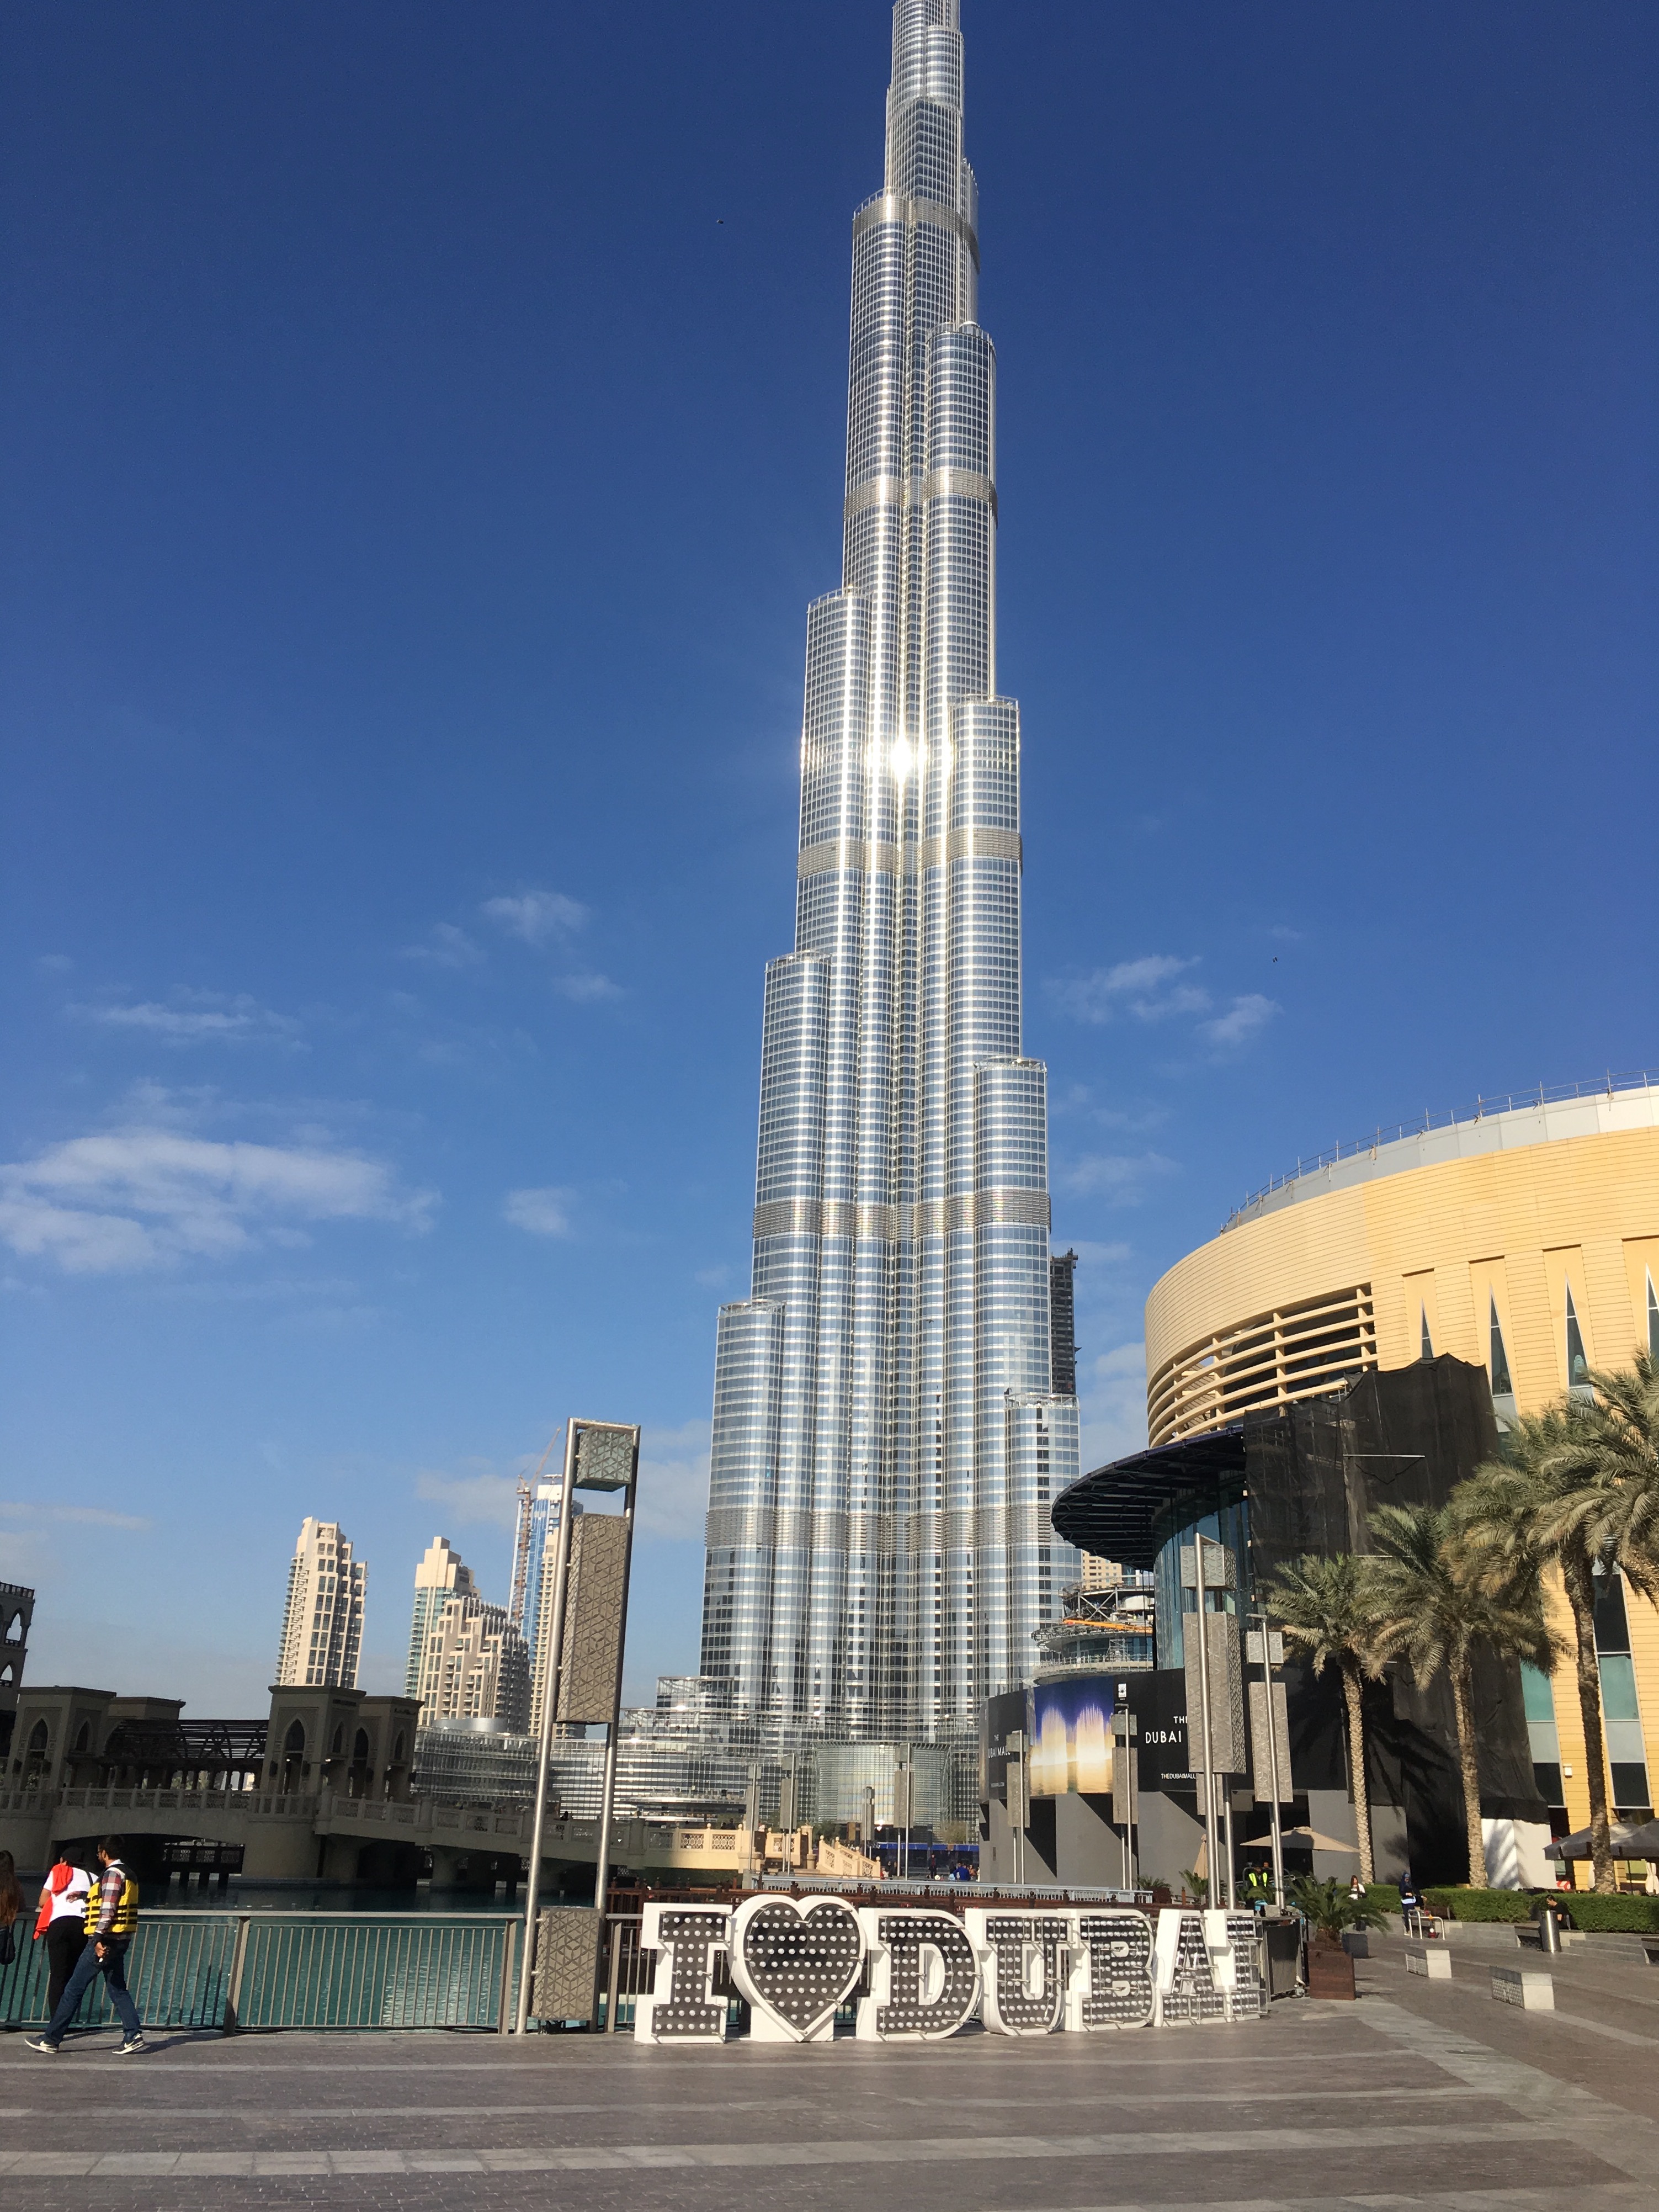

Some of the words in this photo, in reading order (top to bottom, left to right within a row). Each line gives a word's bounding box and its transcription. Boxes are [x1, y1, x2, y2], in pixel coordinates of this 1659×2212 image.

[1145, 1730, 1182, 1744] DUBAI
[634, 1902, 733, 2044] I
[855, 1908, 1268, 2043] DUBAI
